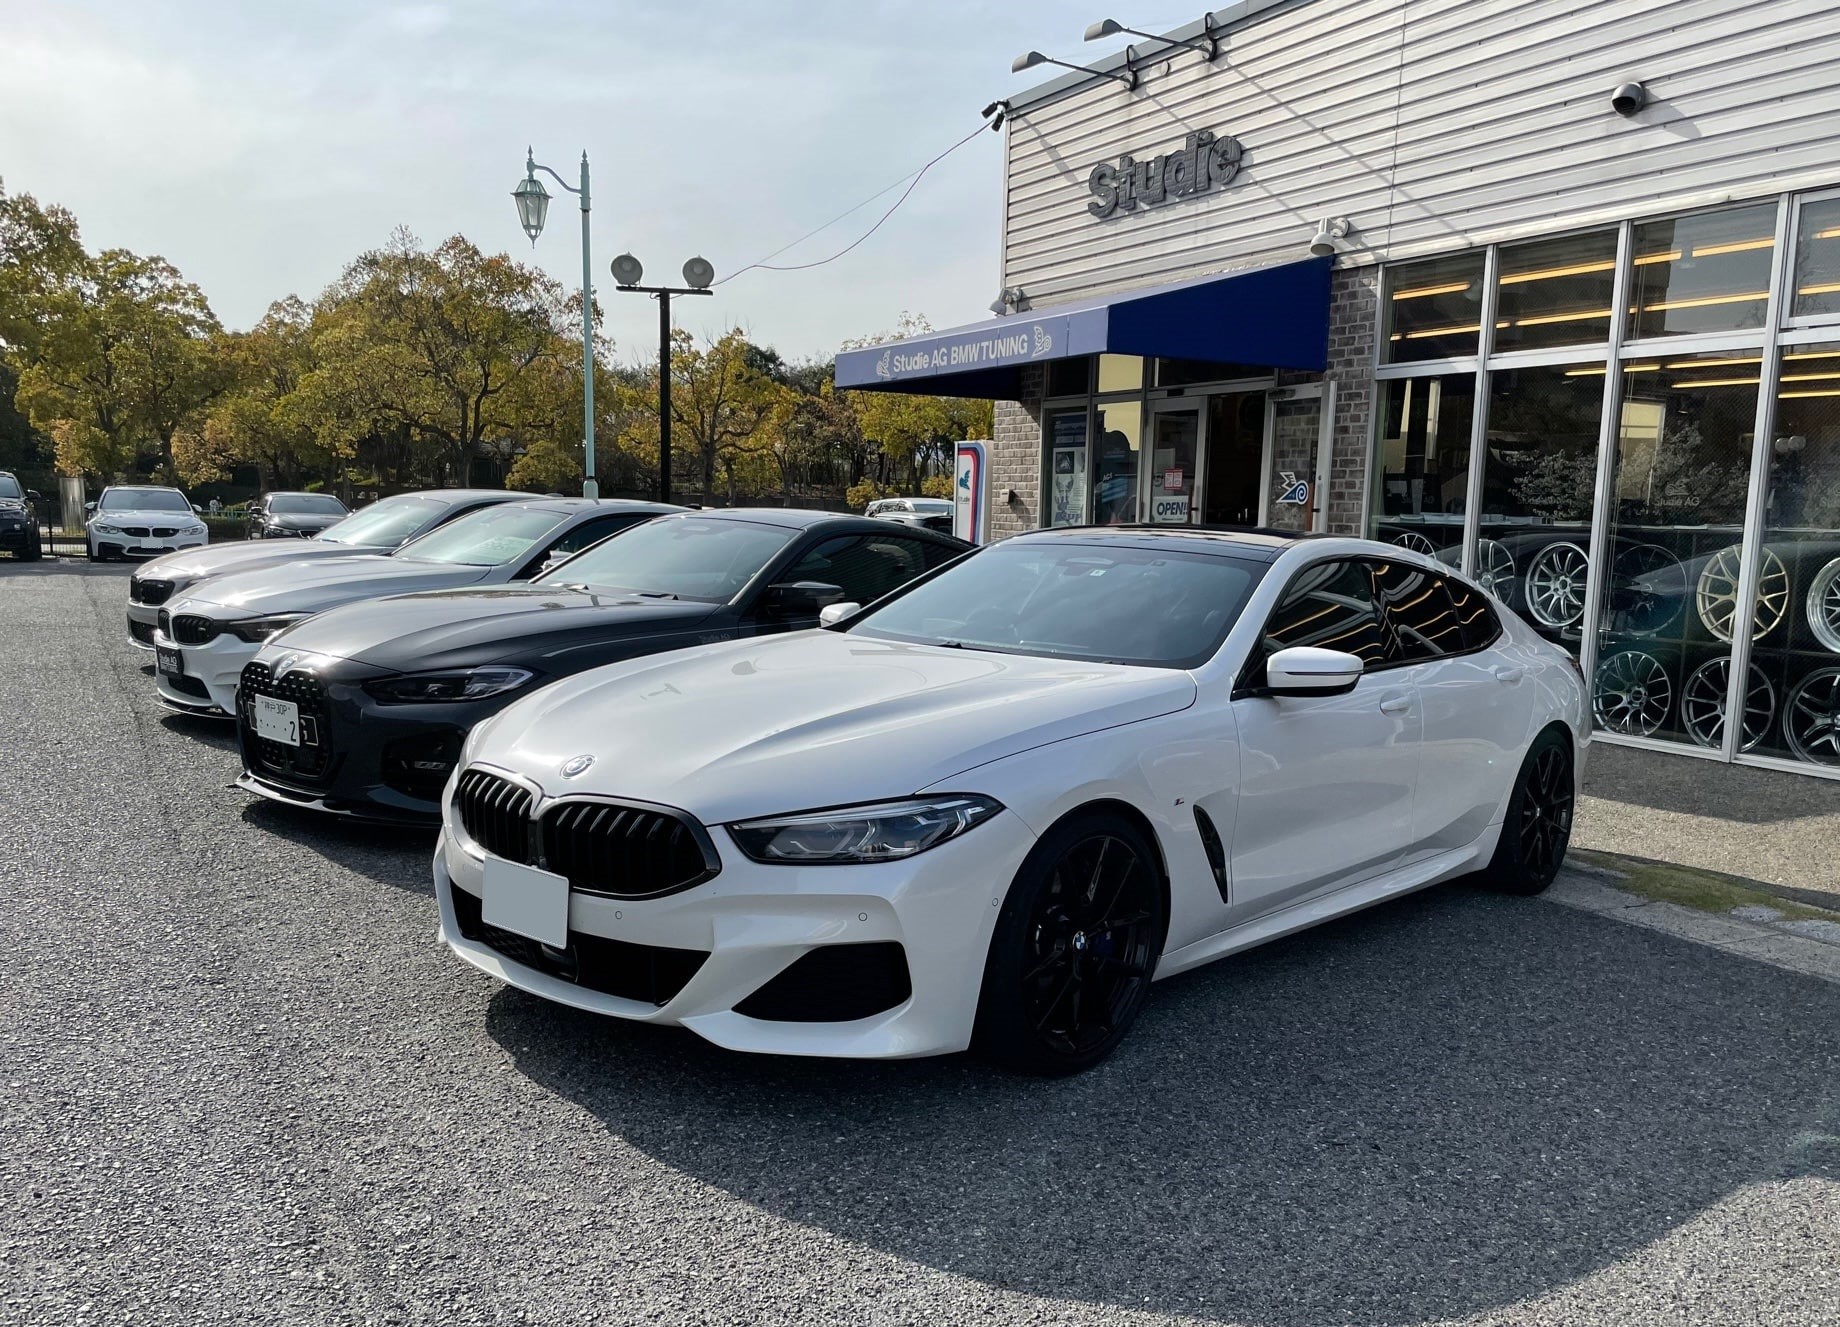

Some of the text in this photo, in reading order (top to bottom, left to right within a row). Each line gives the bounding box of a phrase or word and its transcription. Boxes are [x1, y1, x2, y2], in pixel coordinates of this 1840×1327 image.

[1088, 130, 1242, 218] Studie
[893, 334, 1028, 373] Studie AG BMW TUNING
[1684, 496, 1700, 506] AG
